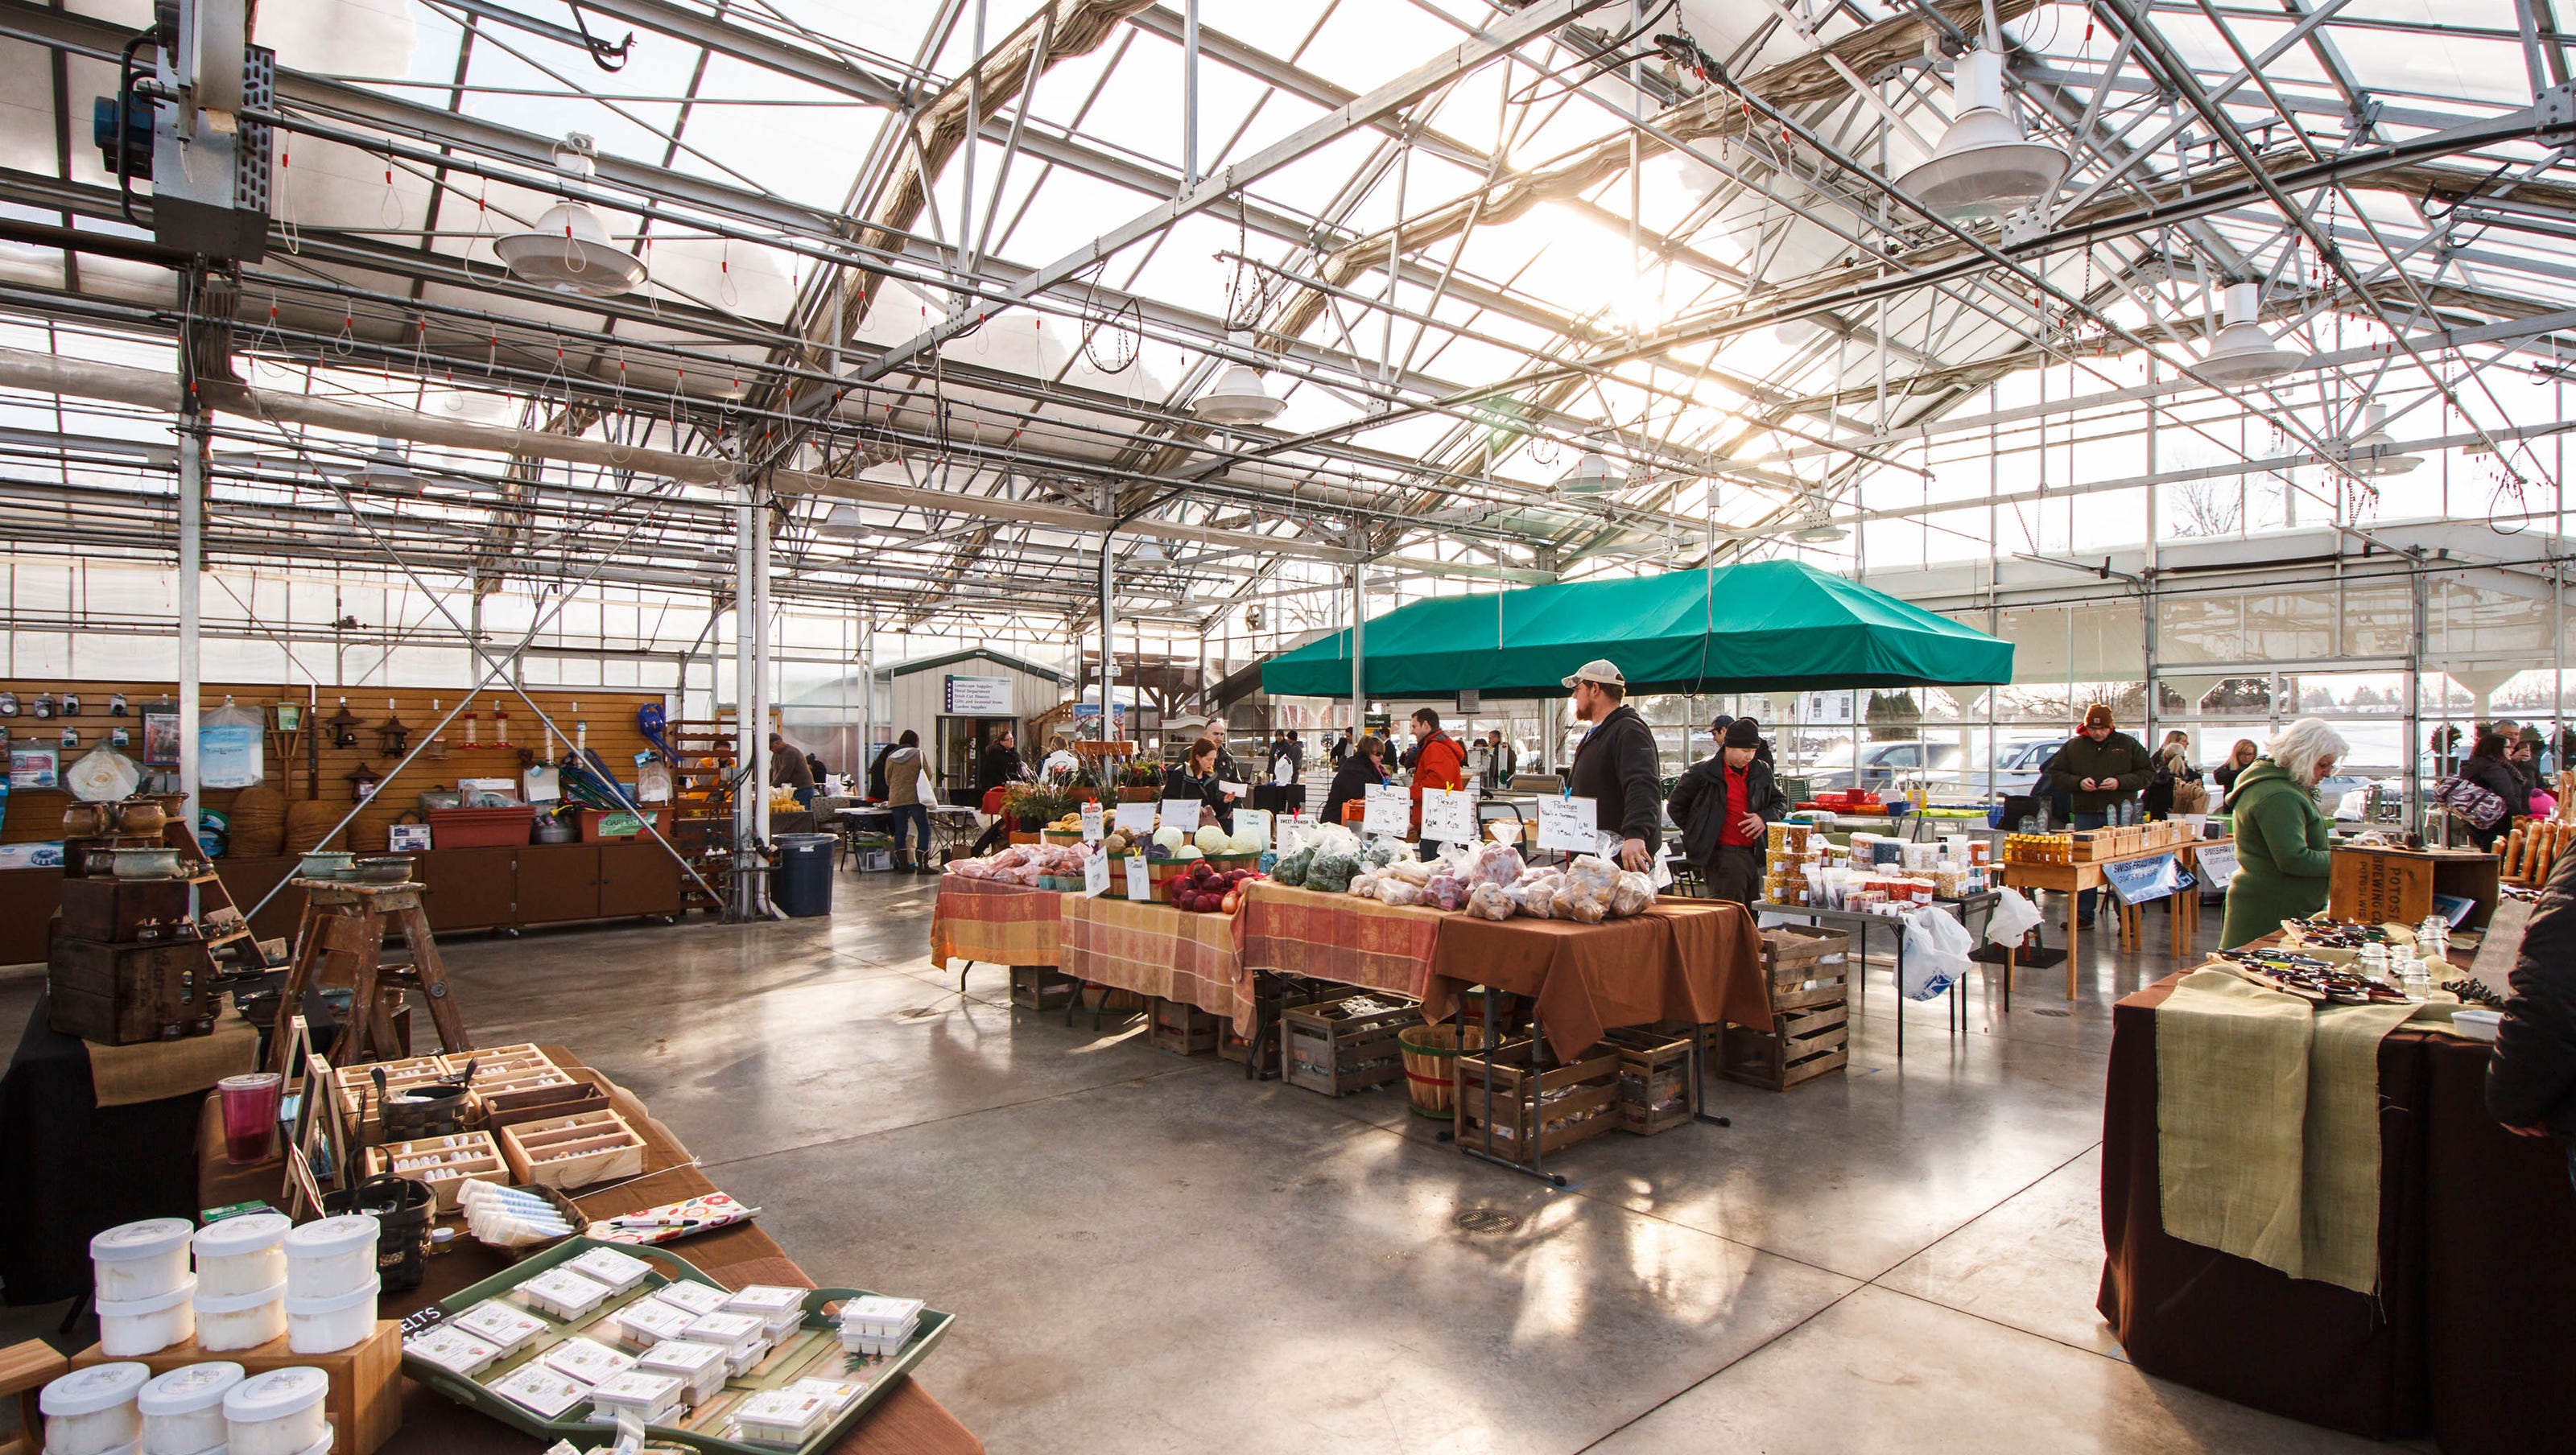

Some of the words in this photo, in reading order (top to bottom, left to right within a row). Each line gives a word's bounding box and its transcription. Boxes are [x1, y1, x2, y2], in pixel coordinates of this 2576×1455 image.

[2113, 862, 2132, 873] SWISS
[2132, 859, 2147, 870] FRAU
[2372, 855, 2384, 909] BREWING
[2388, 868, 2401, 919] POTOSI
[401, 1307, 441, 1333] ELTS
